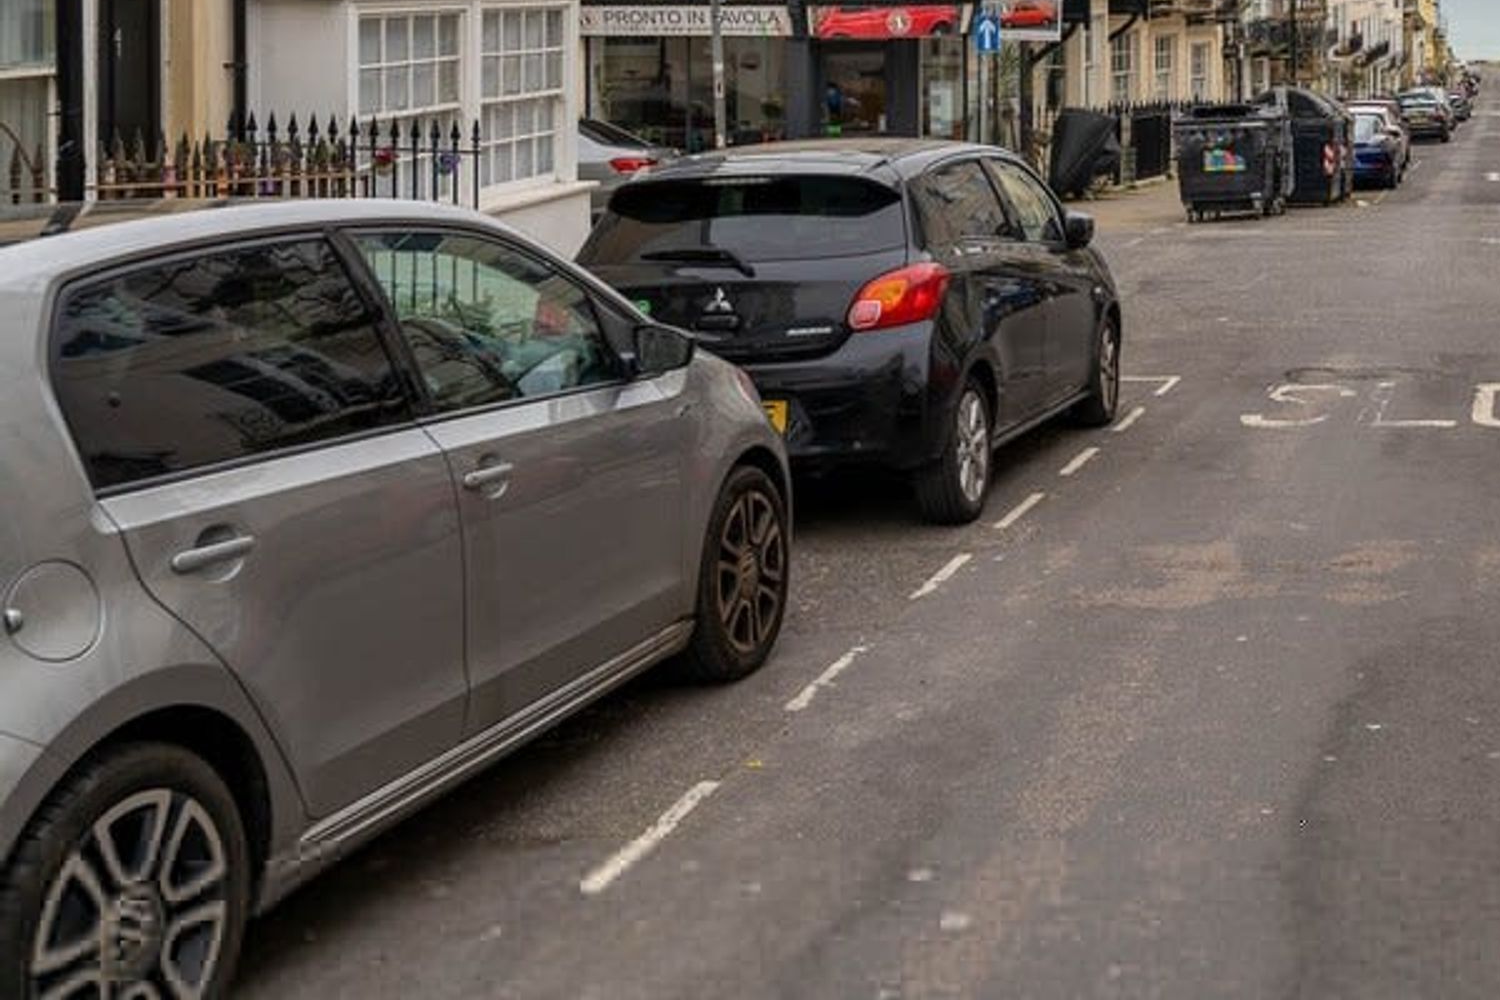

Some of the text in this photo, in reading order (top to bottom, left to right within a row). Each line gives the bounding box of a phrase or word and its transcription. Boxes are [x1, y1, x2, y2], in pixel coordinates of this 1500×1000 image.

[603, 9, 780, 25] PRONTO IN AVOLA
